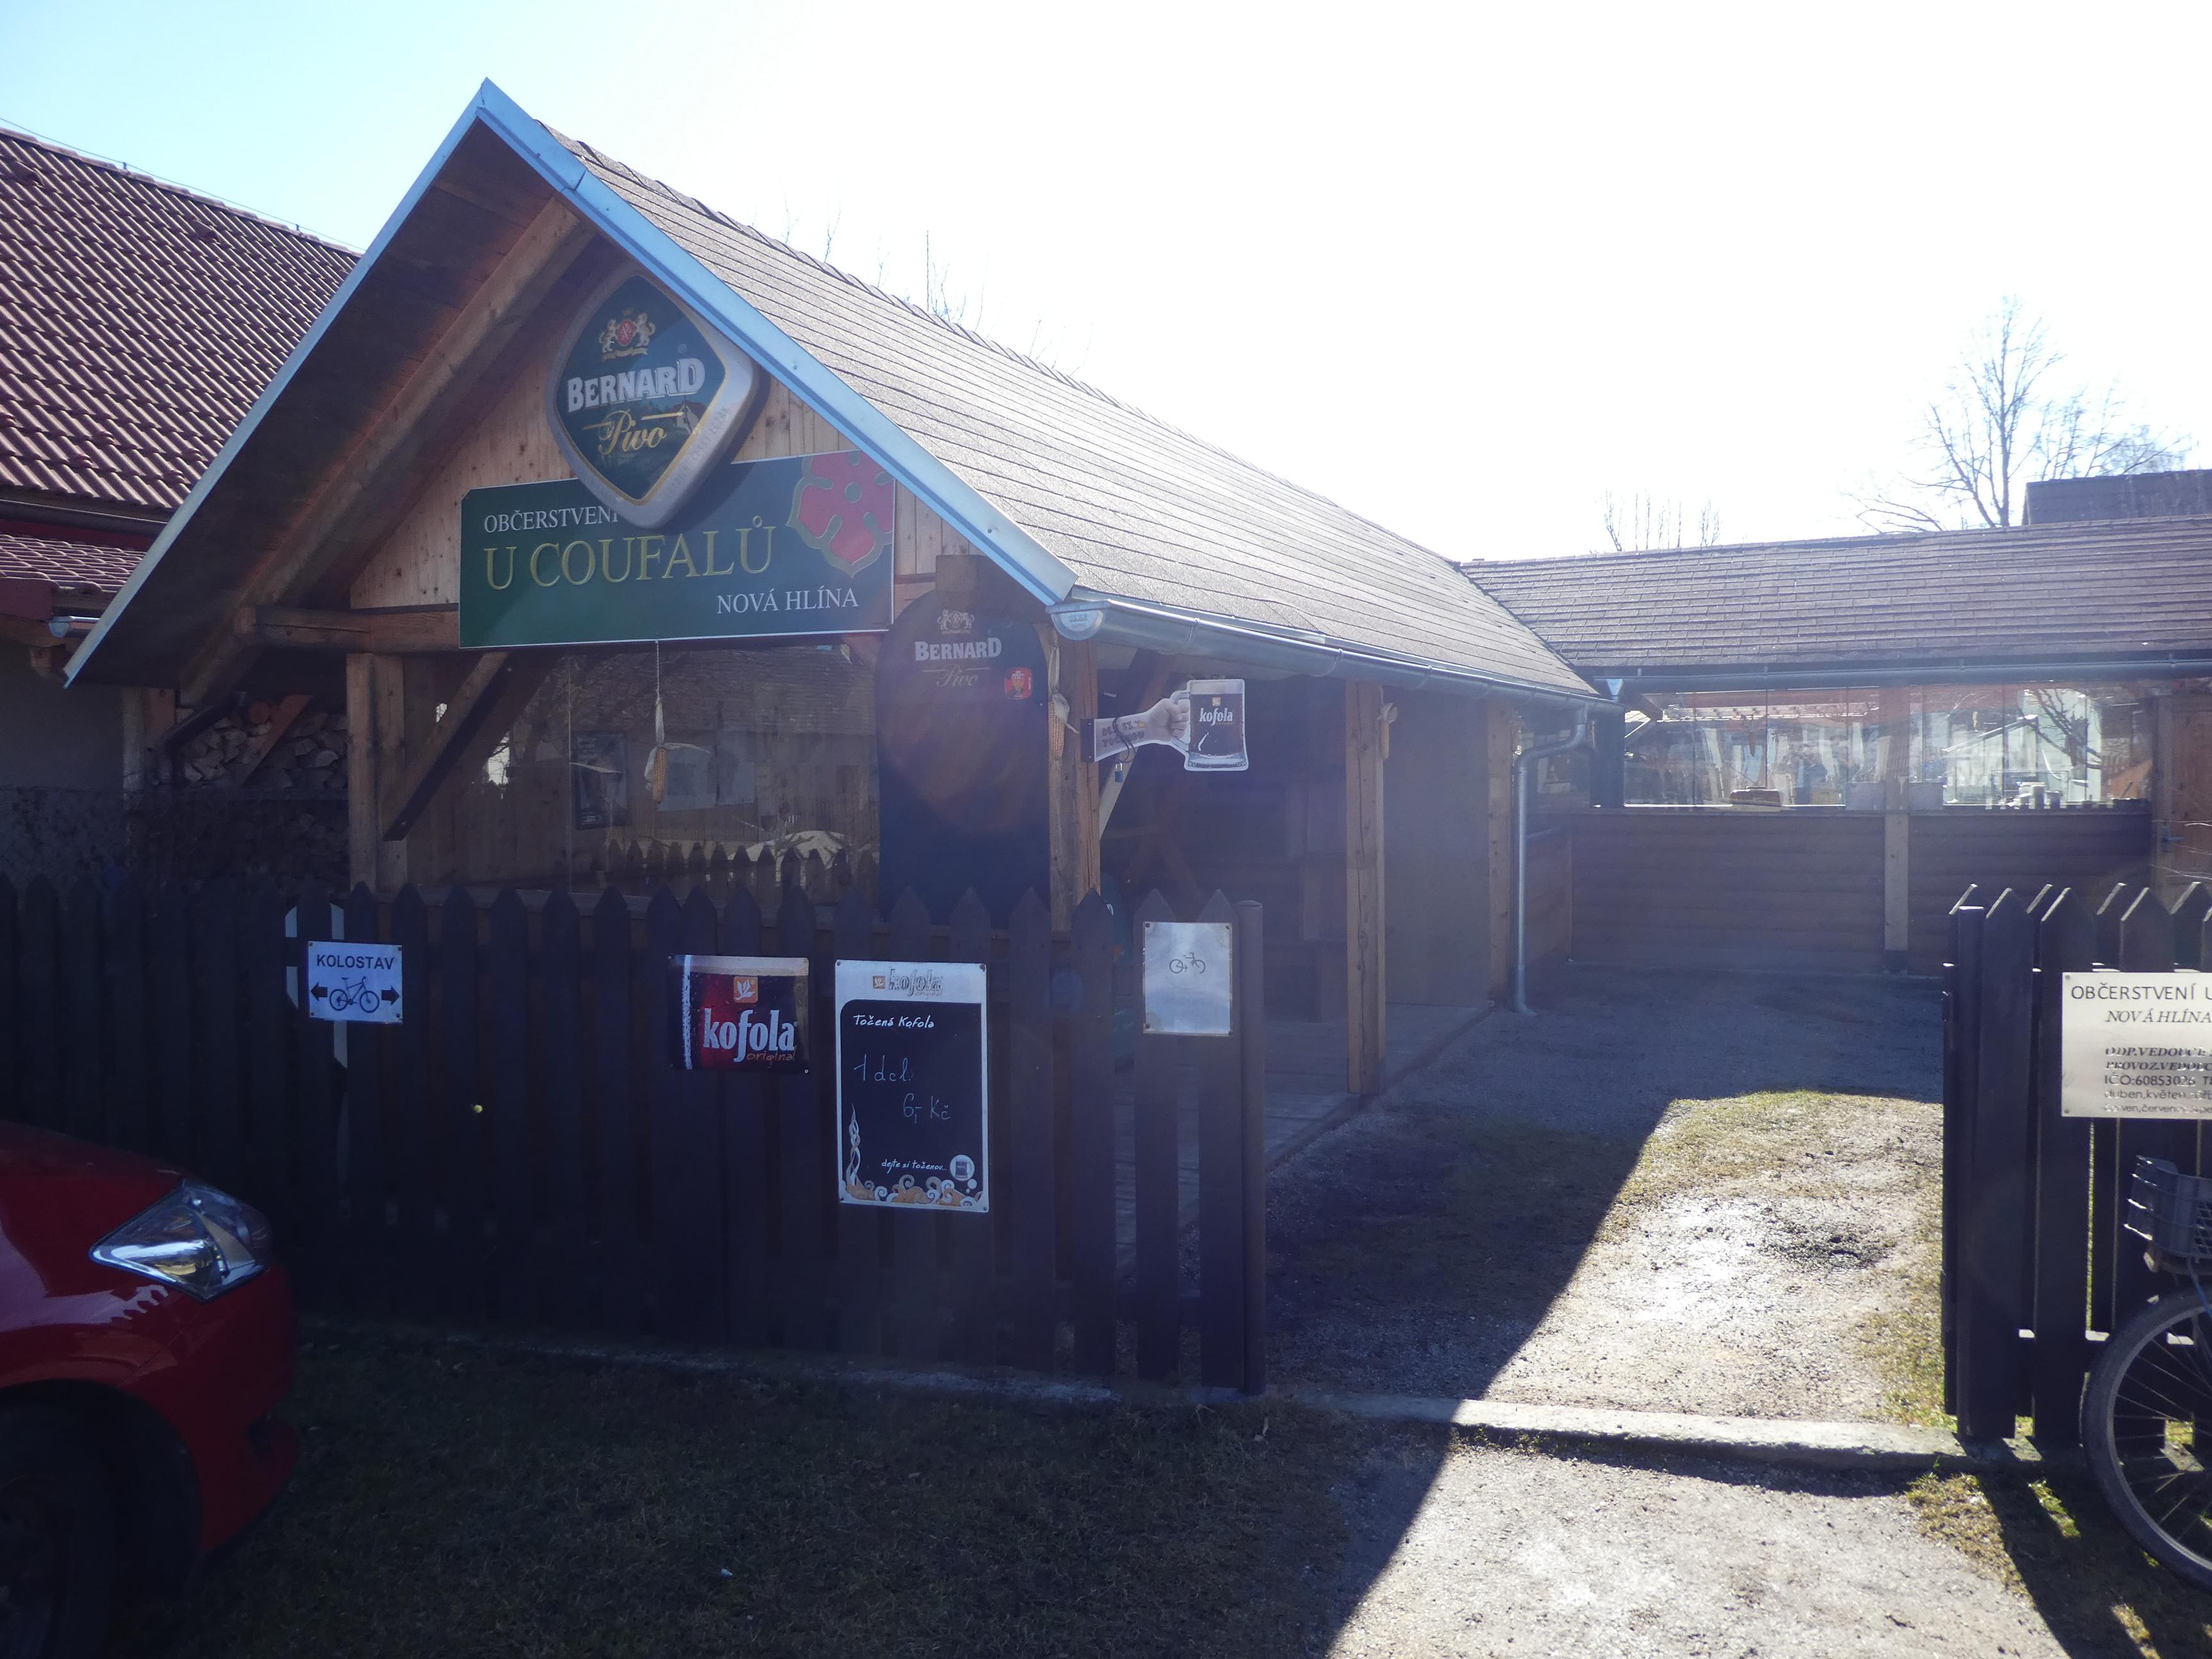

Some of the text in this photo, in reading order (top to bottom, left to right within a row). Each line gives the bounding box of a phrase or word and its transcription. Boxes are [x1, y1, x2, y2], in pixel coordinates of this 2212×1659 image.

[567, 358, 705, 413] BERNARD
[598, 409, 667, 455] Pivo
[484, 515, 776, 589] U COUFALŮ
[717, 585, 860, 614] NOVÁ HLÍNA
[915, 637, 1002, 662] BERNARD
[1199, 707, 1233, 726] kofola
[317, 954, 395, 970] KOLOSTAV
[888, 968, 942, 997] kofola
[2071, 982, 2197, 1000] OBČERSTVENÍ
[853, 1014, 934, 1029] Točená Kofola
[2106, 1008, 2212, 1023] NOVÁ HLÍNA
[703, 1007, 795, 1062] kofola
[746, 1045, 797, 1069] original
[854, 1054, 867, 1081] 1
[930, 1095, 951, 1120] Kč
[881, 1158, 901, 1174] dejte
